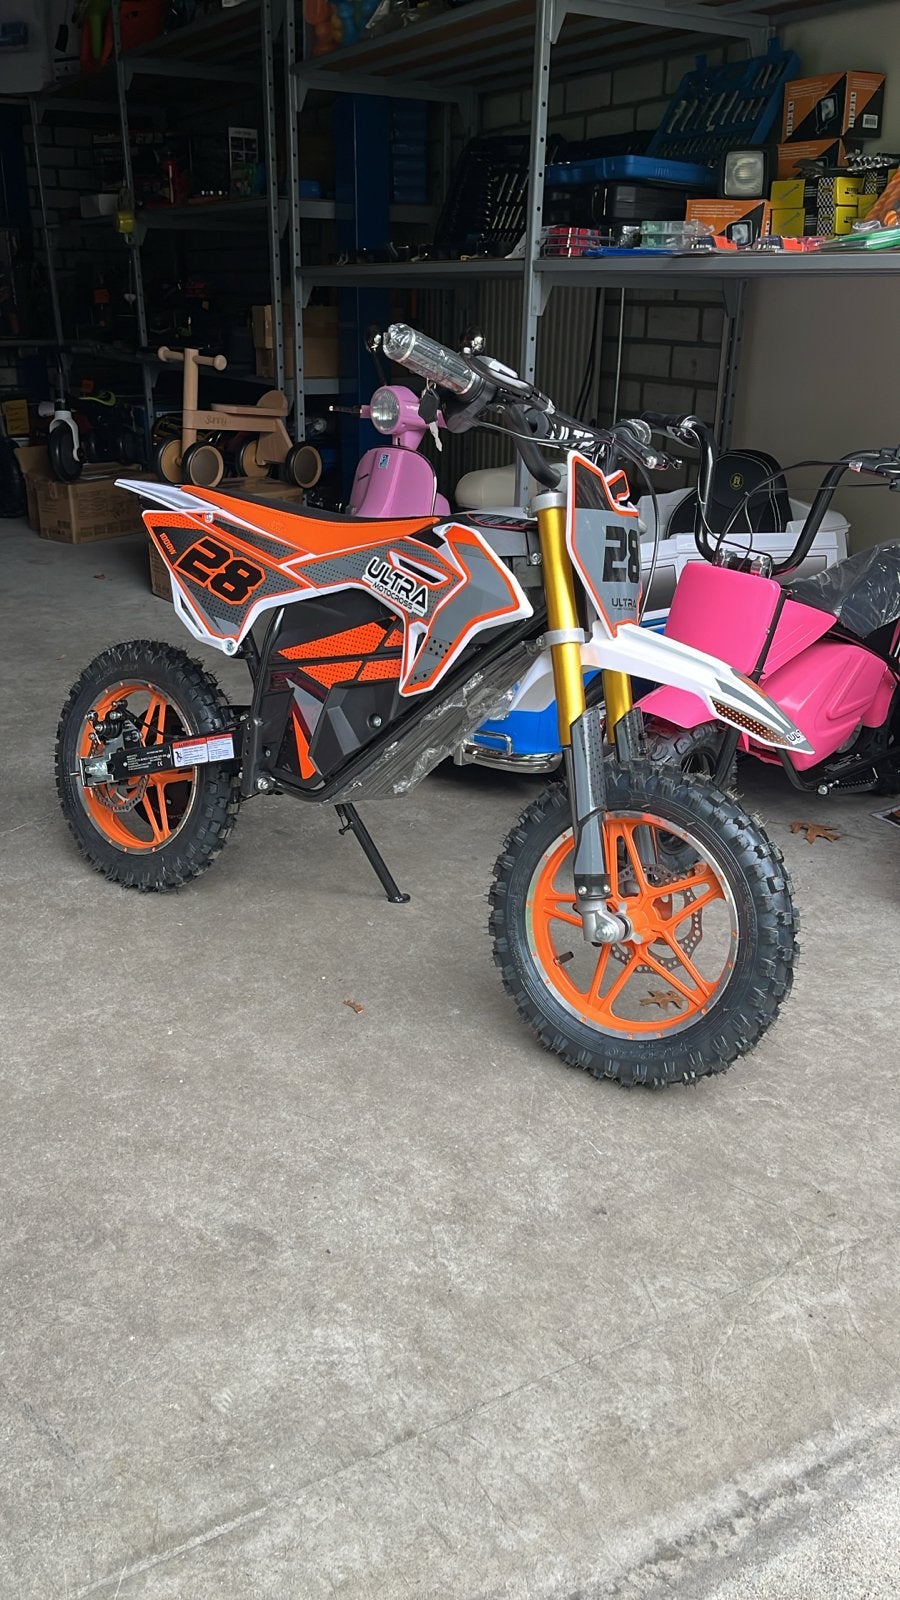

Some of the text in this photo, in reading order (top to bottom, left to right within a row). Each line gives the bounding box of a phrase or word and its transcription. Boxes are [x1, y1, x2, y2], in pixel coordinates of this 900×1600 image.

[159, 533, 177, 555] 1000W
[602, 525, 641, 583] 28
[174, 537, 265, 604] 28
[367, 558, 427, 610] ULTRA
[372, 582, 414, 610] MOTOCROSS
